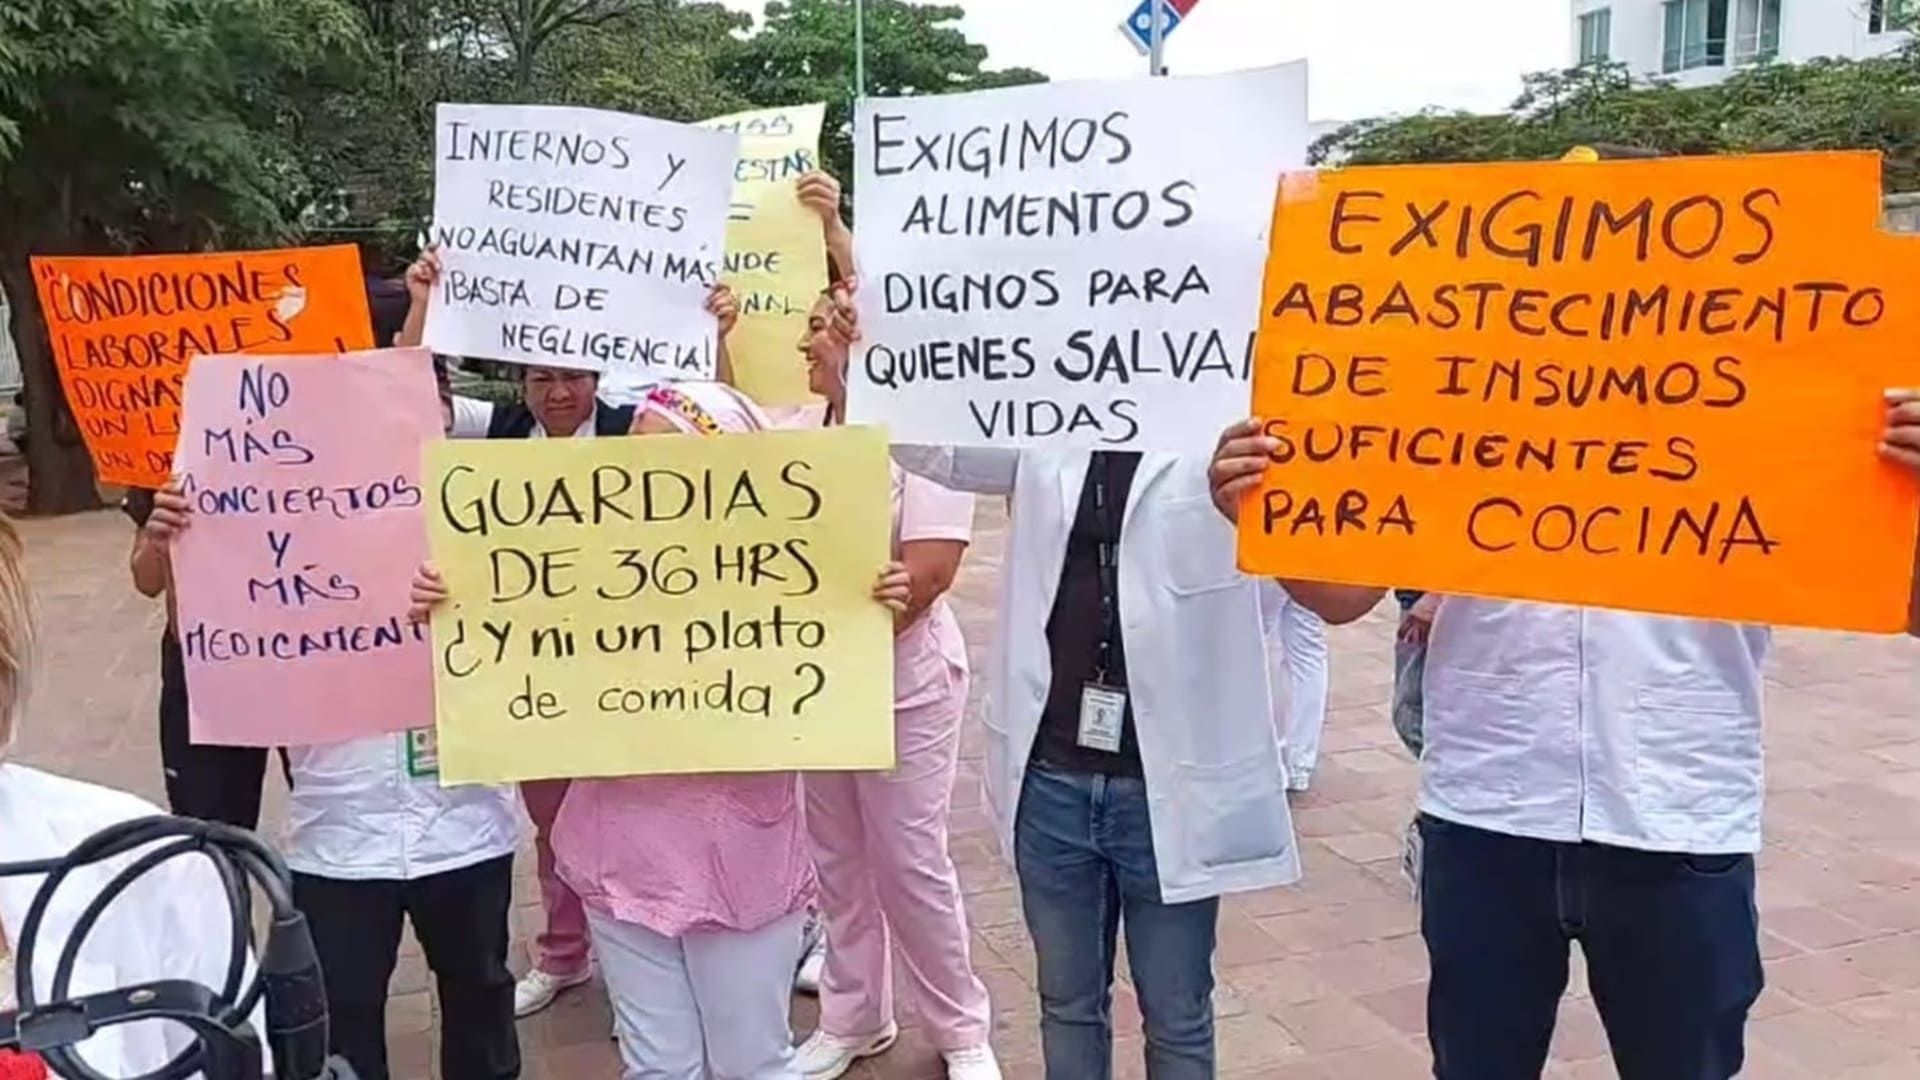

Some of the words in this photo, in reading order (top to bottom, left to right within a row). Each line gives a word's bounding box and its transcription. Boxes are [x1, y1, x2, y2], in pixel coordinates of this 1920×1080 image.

[446, 121, 630, 169] INTERNOS
[734, 148, 813, 182] ESTAR
[873, 112, 1132, 178] EXIGIMOS
[489, 181, 688, 232] RESIDENTES
[902, 181, 1196, 236] ALIMENTOS
[1330, 189, 1780, 267] EXIGIMOS
[723, 252, 780, 273] NDE
[885, 270, 1060, 313] DIGNOS
[1089, 265, 1210, 308] PARA
[555, 284, 609, 311] DE
[1272, 282, 1885, 341] ABASTECIMIENTO
[64, 308, 292, 371] LABORALES
[502, 324, 711, 379] NEGLIGENCIA!
[865, 337, 1036, 390] QUIENES
[1055, 330, 1256, 383] SALVA
[240, 364, 289, 418] NO
[1292, 353, 1388, 397] DE
[1436, 355, 1747, 408] INSUMOS
[204, 417, 314, 465] MÁS
[969, 399, 1139, 443] VIDAS
[1263, 419, 1698, 480] SUFICIENTES
[441, 460, 822, 536] GUARDIAS
[267, 531, 291, 568] Y
[1264, 490, 1416, 537] PARA
[1467, 496, 1779, 563] COCINA
[248, 564, 360, 605] MÁS
[489, 547, 581, 603] DE
[597, 545, 698, 600] 36
[715, 539, 819, 597] HRS
[532, 616, 575, 659] ni
[596, 621, 661, 654] un
[684, 605, 825, 663] plato
[509, 675, 567, 721] de
